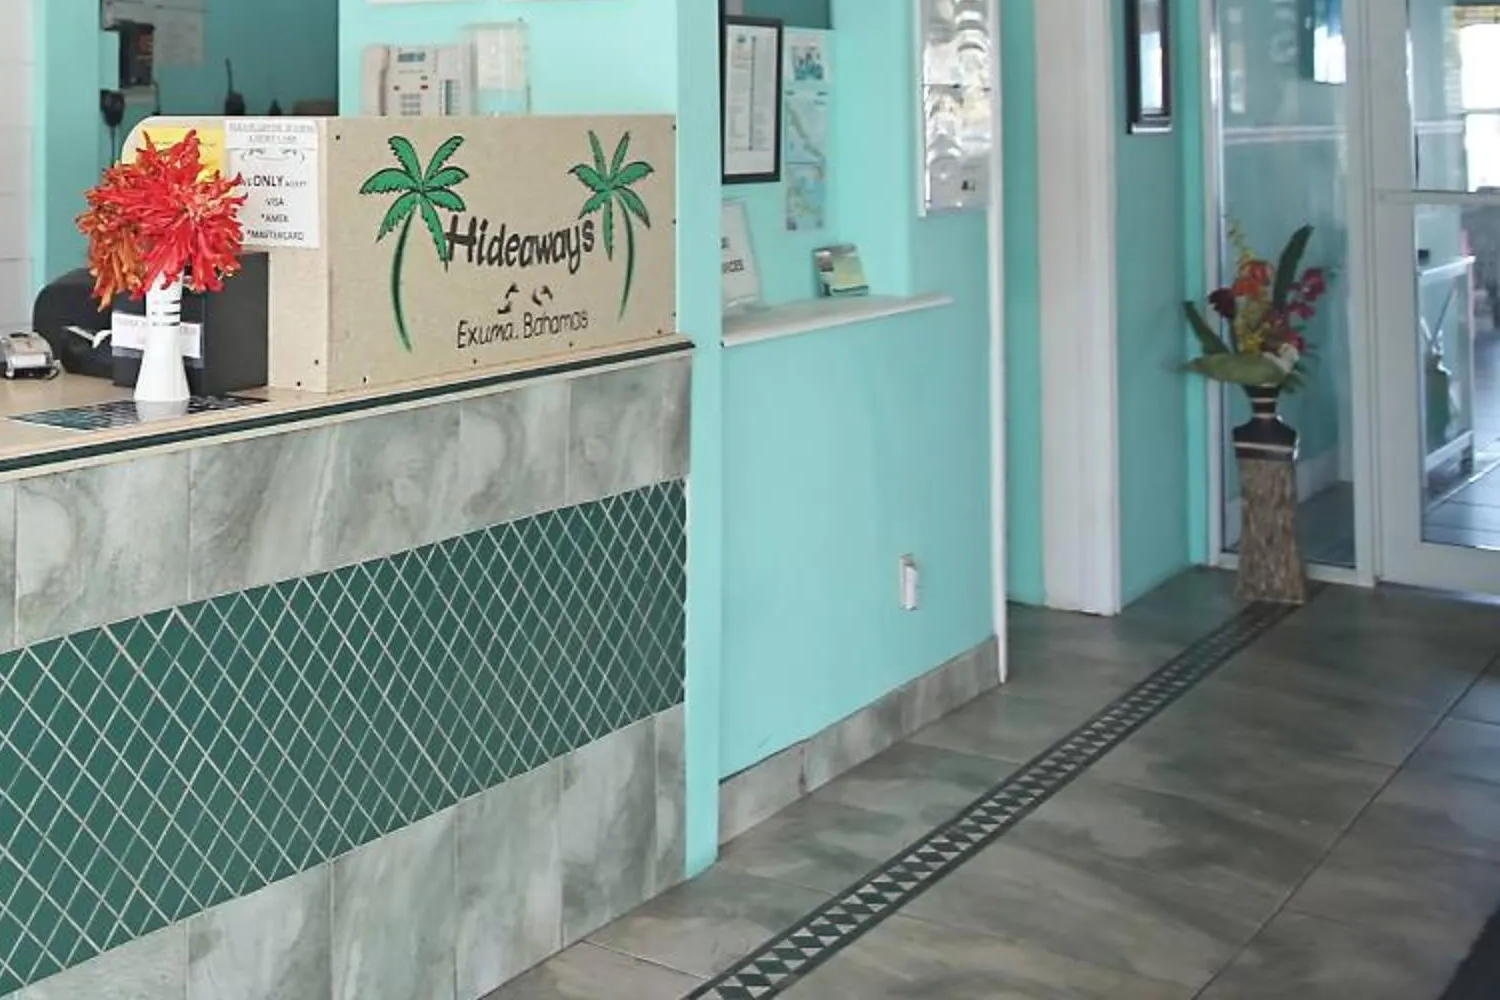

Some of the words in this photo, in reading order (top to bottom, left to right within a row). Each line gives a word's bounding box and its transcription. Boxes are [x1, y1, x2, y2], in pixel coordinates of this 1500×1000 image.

[253, 175, 284, 187] ONLY
[444, 214, 595, 275] Hideaways
[524, 310, 588, 339] Bahamas
